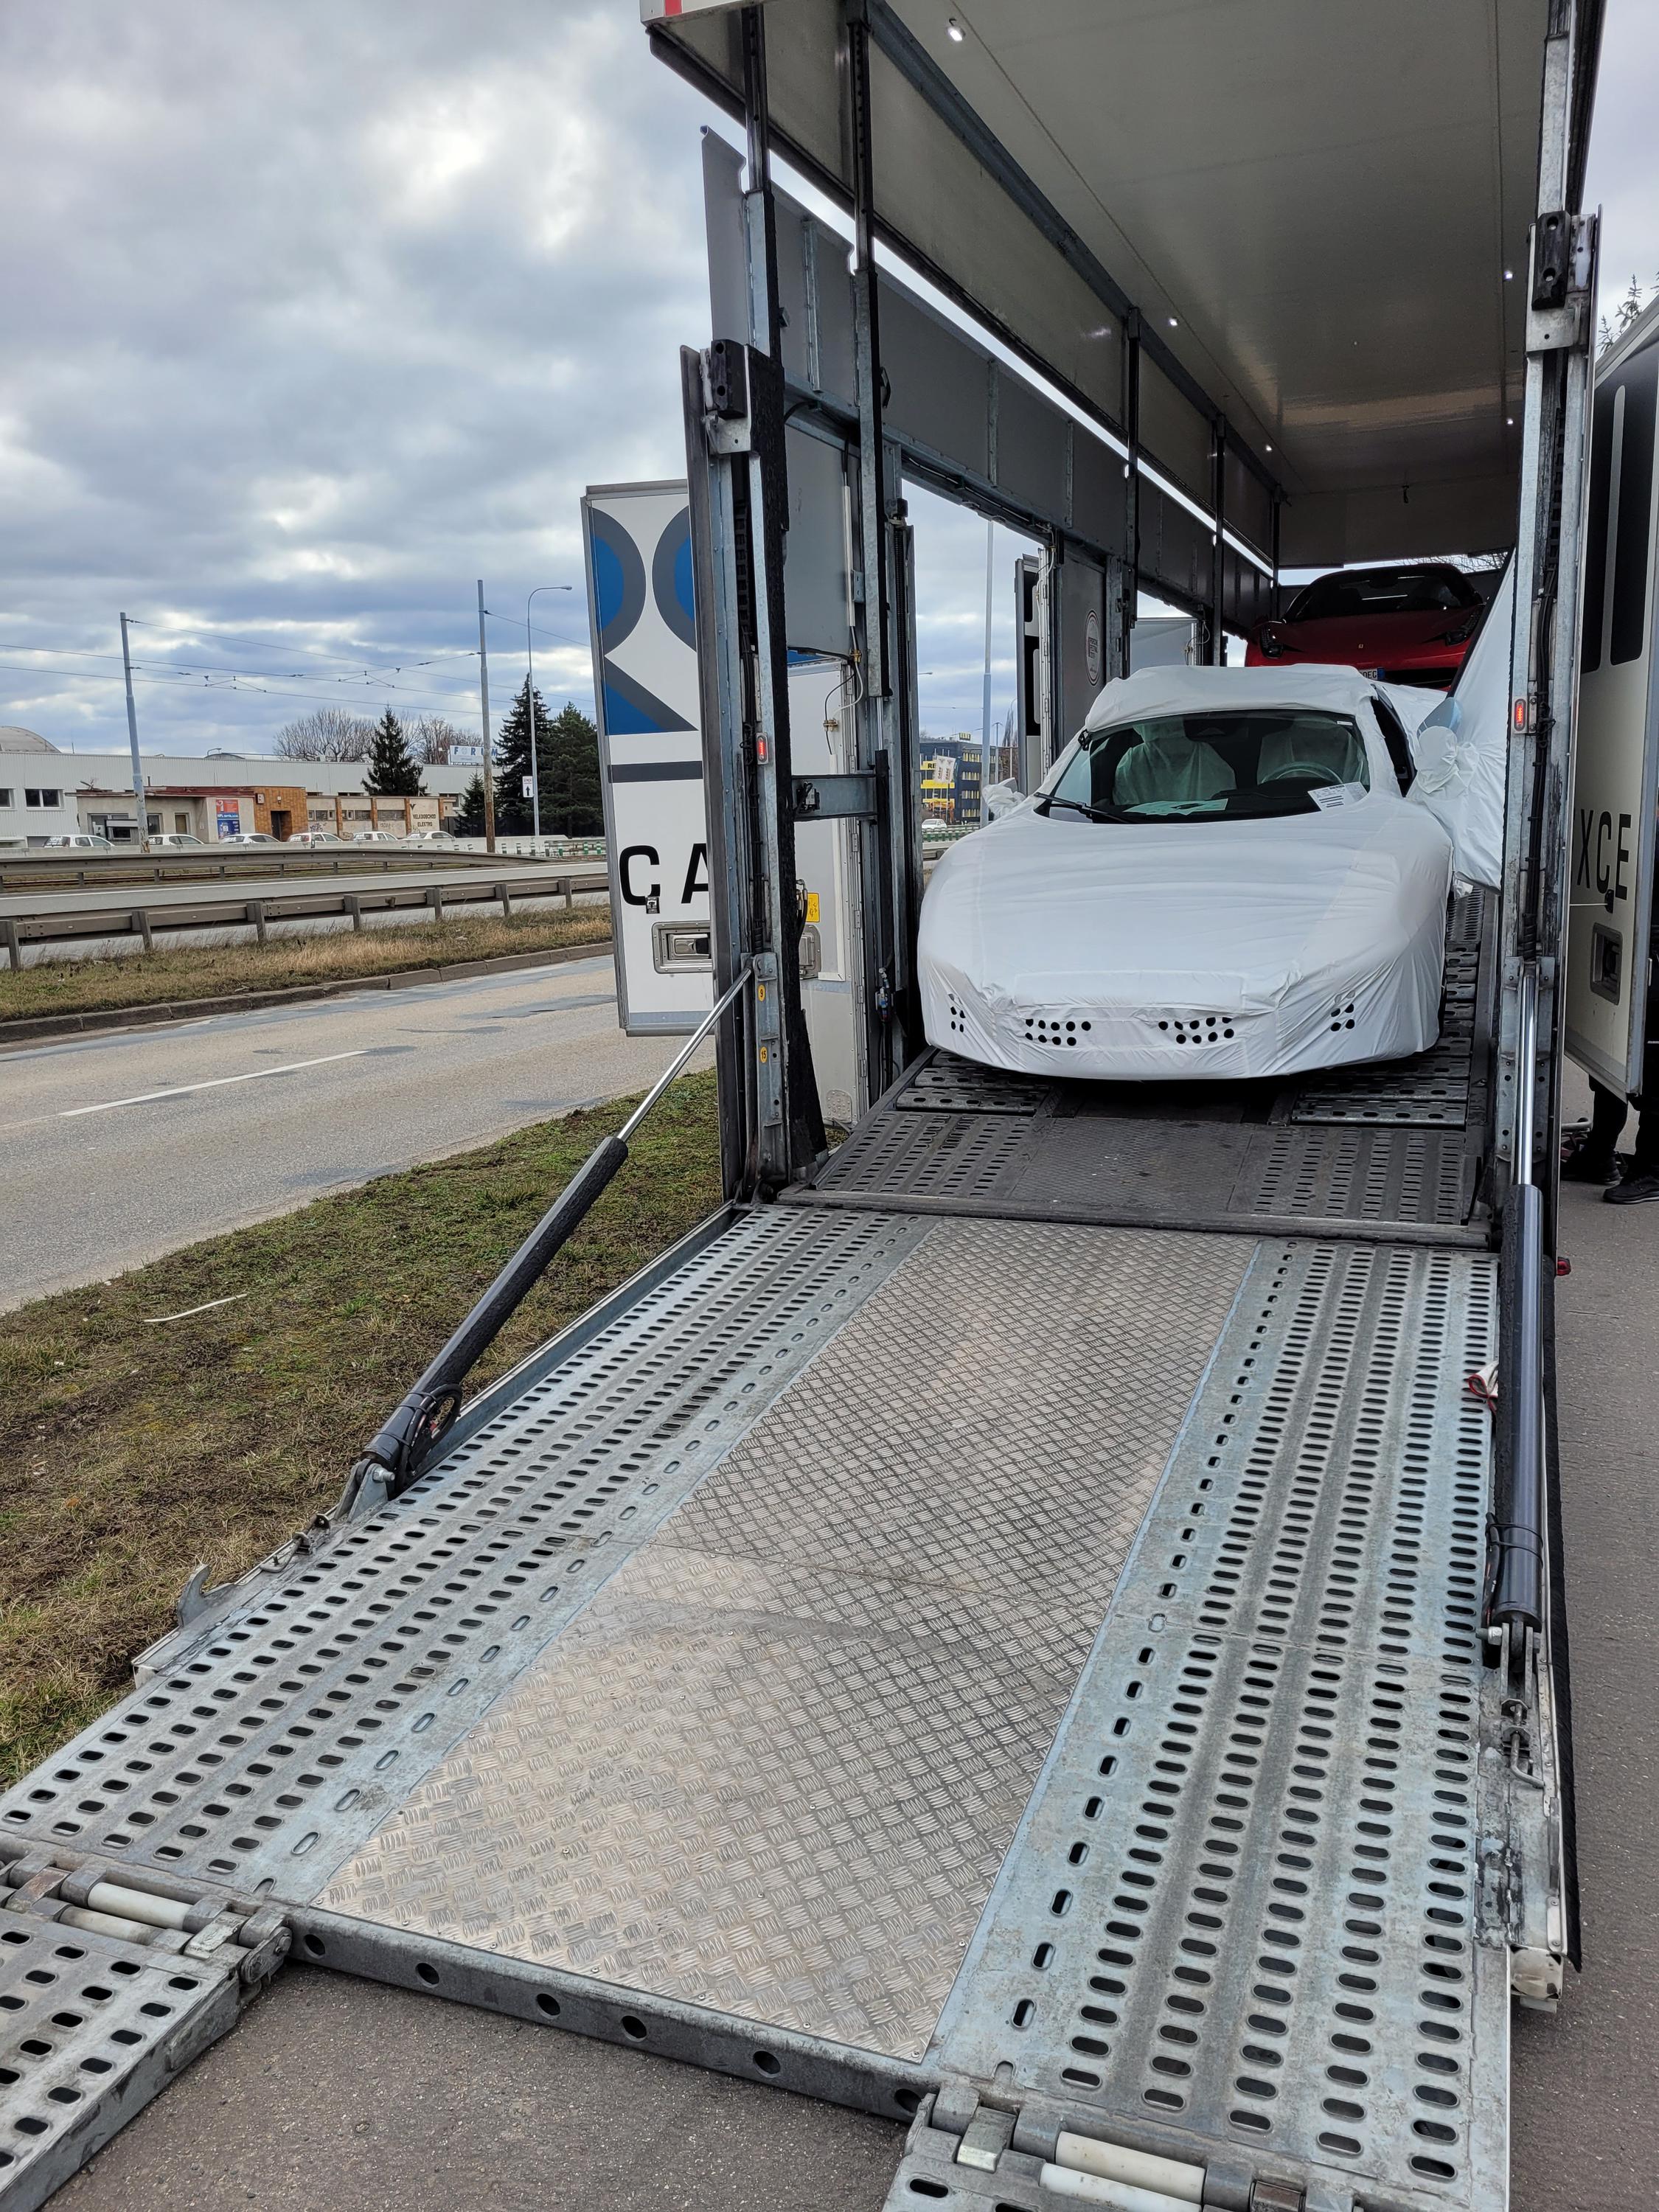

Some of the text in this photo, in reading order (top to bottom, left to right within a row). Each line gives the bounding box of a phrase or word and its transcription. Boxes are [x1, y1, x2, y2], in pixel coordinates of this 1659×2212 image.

[1573, 809, 1631, 901] XCE
[759, 989, 764, 998] 9
[761, 1050, 767, 1058] 15
